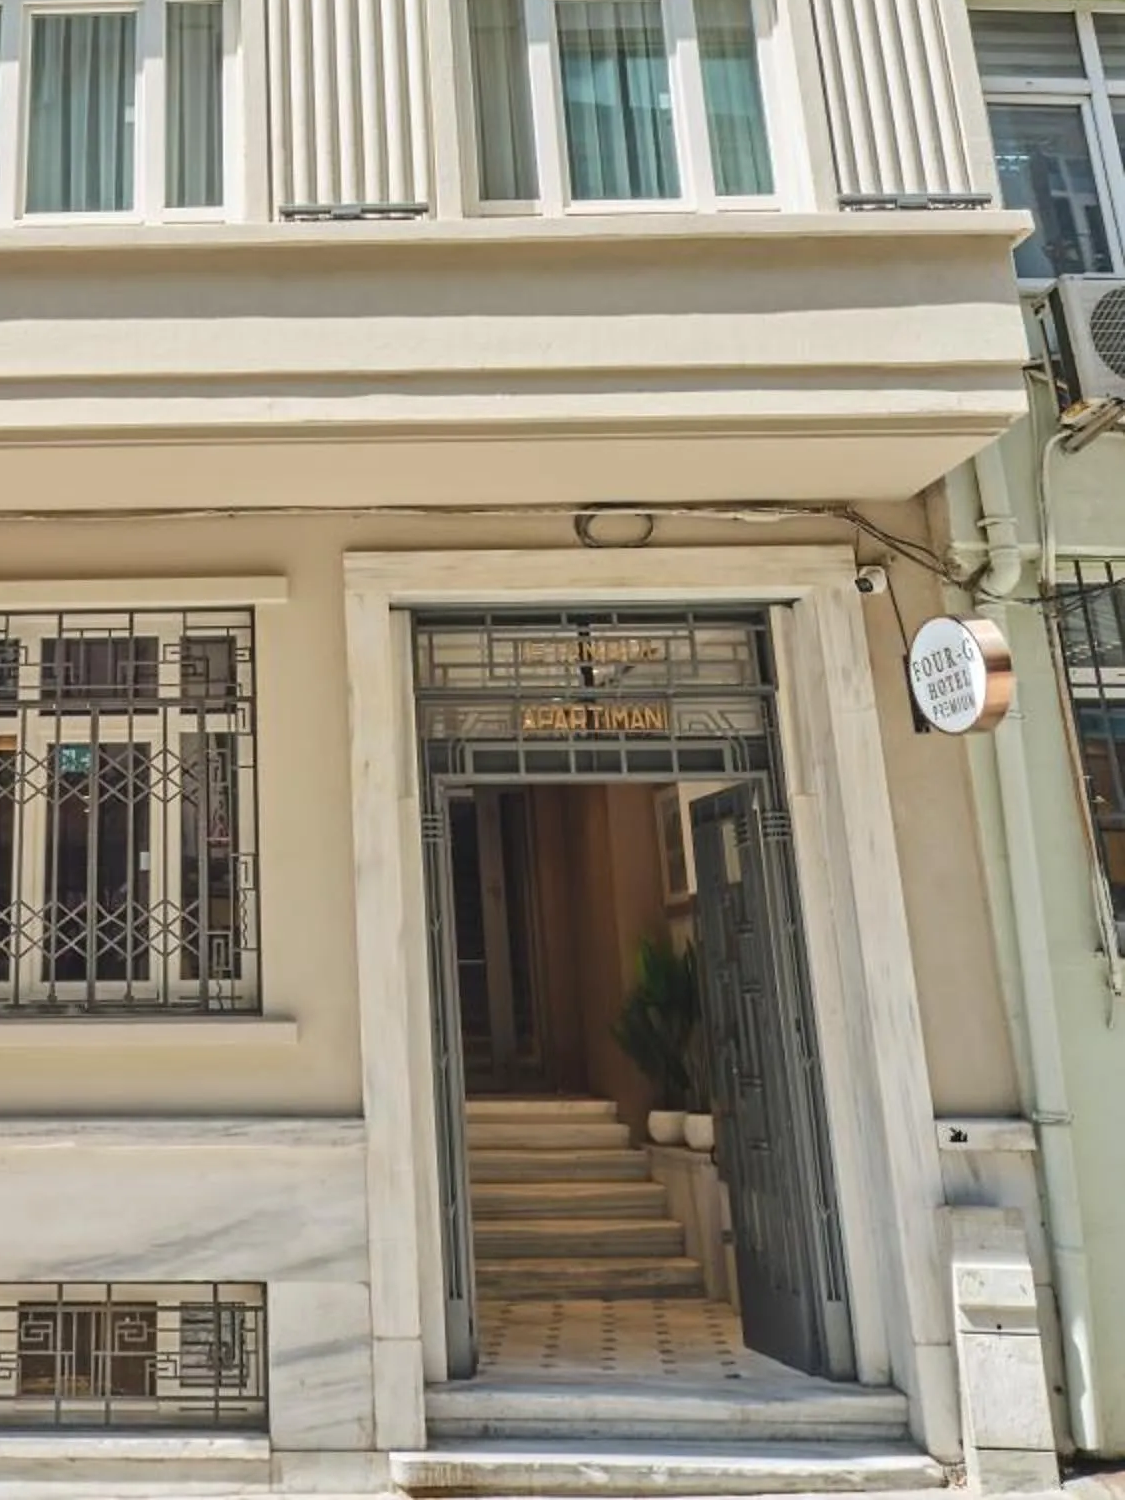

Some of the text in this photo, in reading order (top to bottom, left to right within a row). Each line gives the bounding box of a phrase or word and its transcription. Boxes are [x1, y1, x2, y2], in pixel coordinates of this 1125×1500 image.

[912, 638, 974, 682] FOUR-G
[927, 669, 972, 701] HOTEL
[932, 694, 976, 721] PREMIUM
